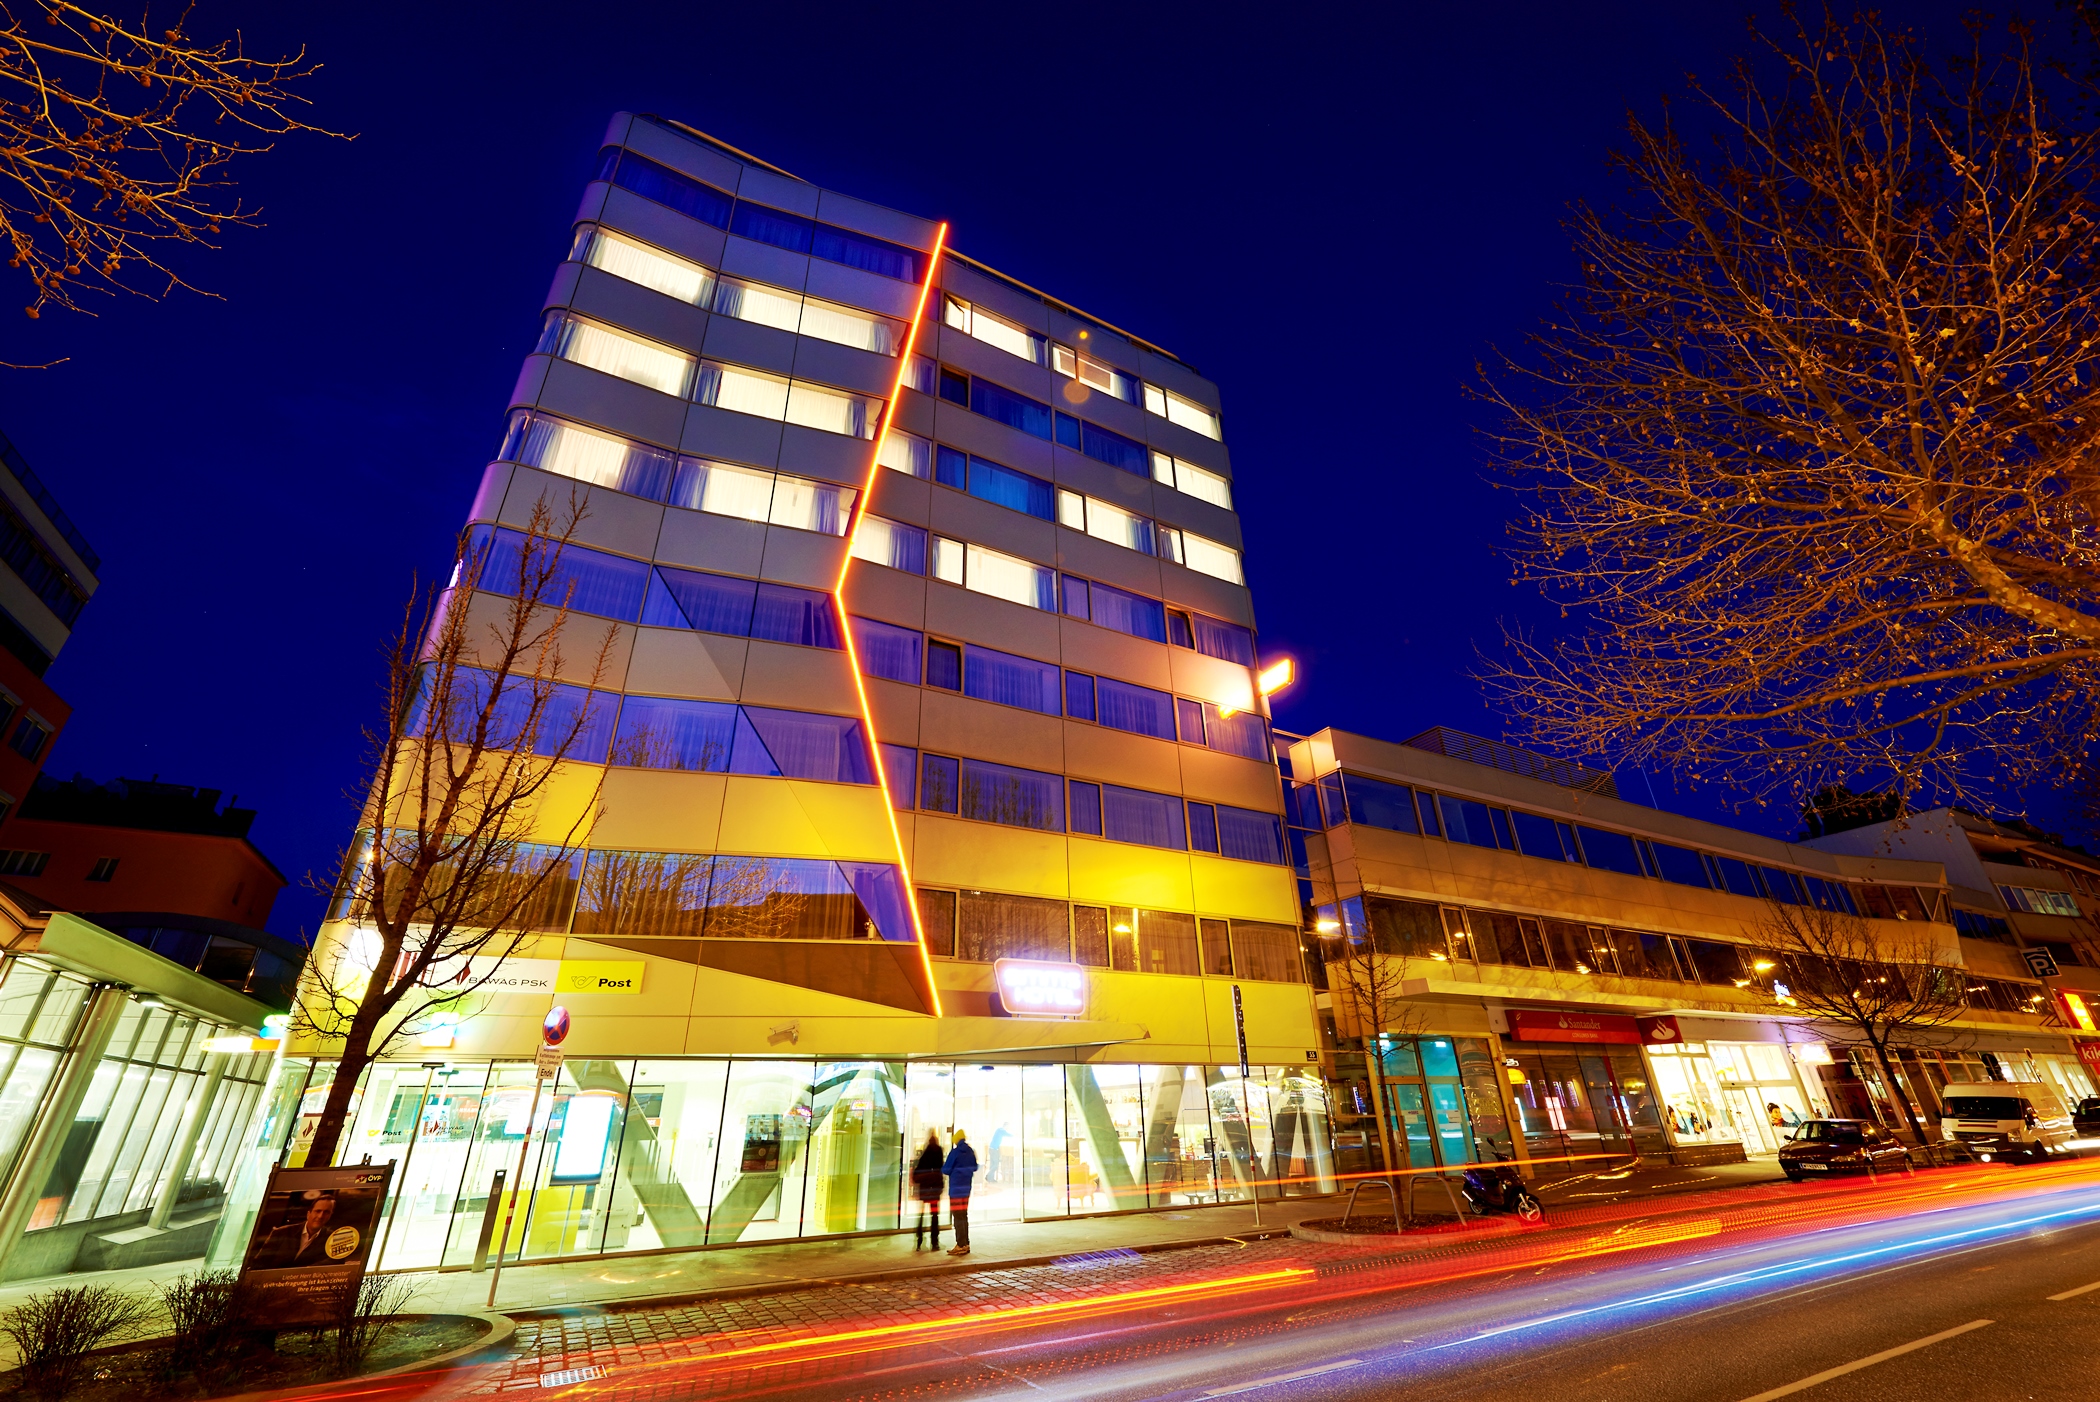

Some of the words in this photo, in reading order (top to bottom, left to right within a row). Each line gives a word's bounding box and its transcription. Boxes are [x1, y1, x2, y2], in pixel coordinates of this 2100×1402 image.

[2030, 958, 2049, 976] P
[468, 976, 517, 986] BAWAG
[520, 977, 548, 988] PSK
[598, 977, 631, 988] Post
[1568, 1018, 1600, 1029] Santander
[540, 1068, 552, 1077] Ende
